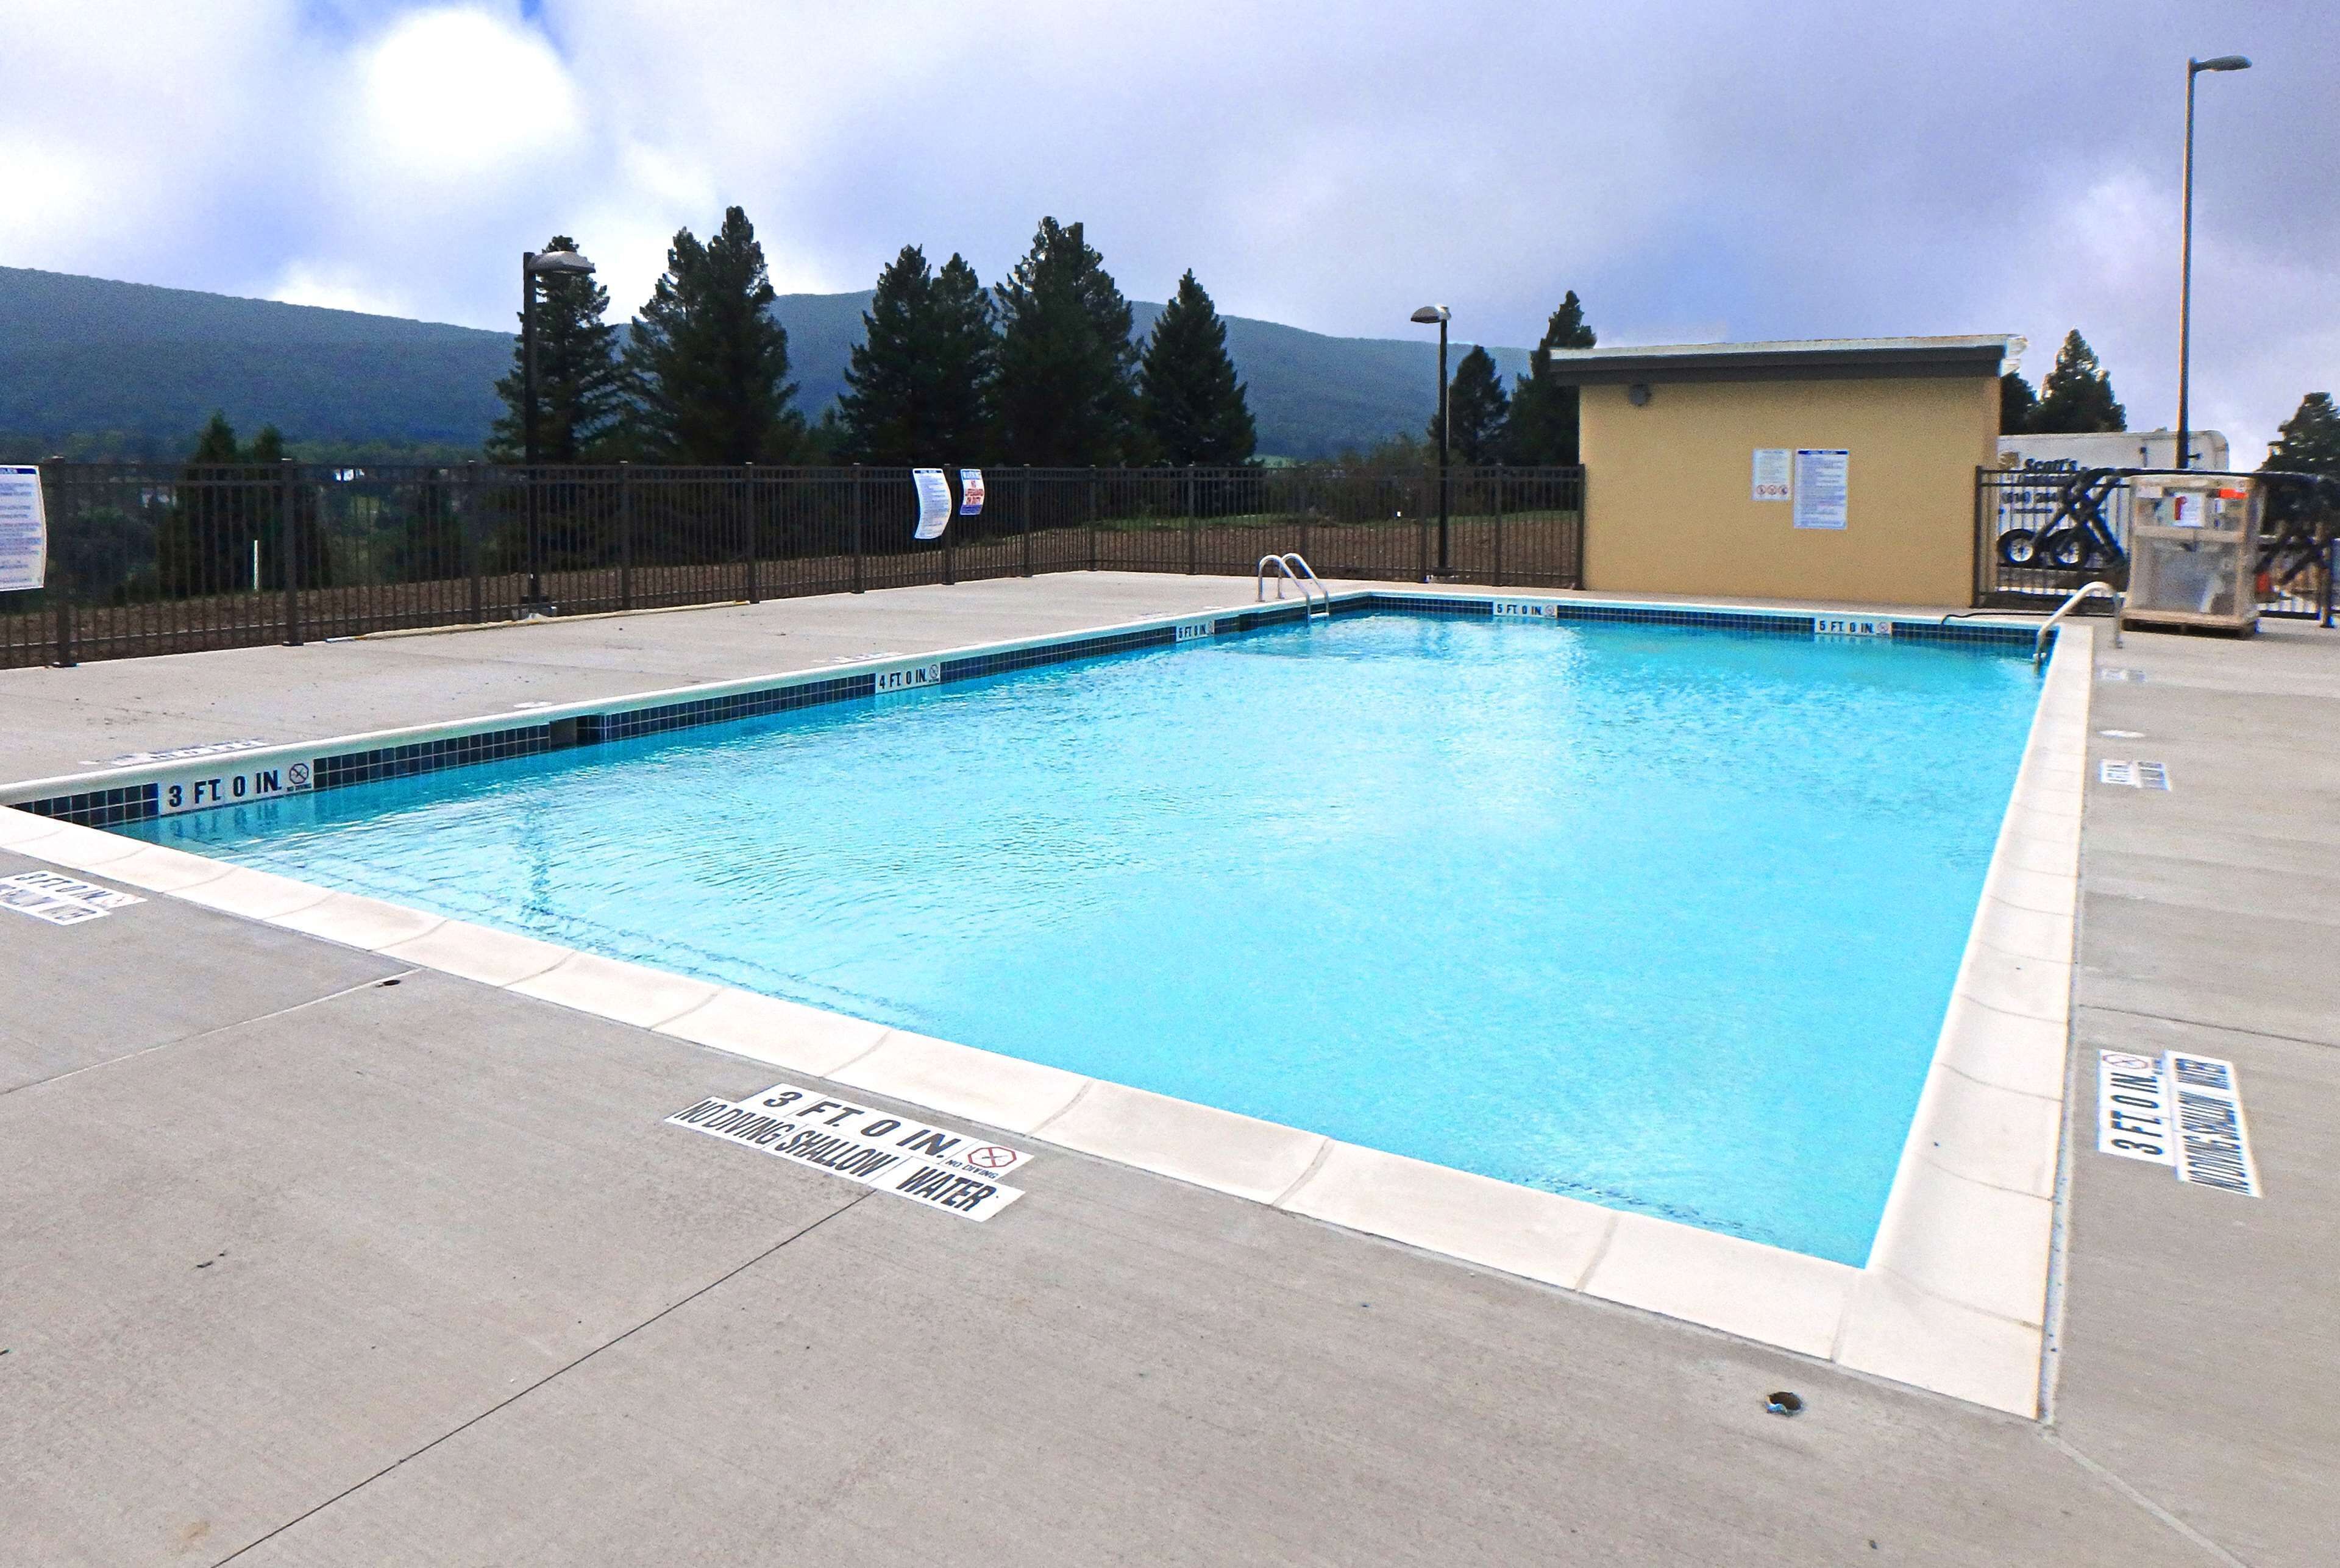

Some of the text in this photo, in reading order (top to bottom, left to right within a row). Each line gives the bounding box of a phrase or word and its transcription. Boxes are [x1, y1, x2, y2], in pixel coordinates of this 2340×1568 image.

[1498, 605, 1502, 613] 5
[880, 675, 885, 689] 4
[169, 785, 182, 807] 3
[194, 779, 221, 804] FT.
[256, 770, 282, 793] IN.
[763, 1092, 803, 1107] 3
[796, 1101, 864, 1127] FT.
[896, 1129, 961, 1158] IN.
[674, 1101, 997, 1211] NO DIVING SHALLOW WATER
[2111, 1138, 2163, 1155] 3
[945, 1160, 998, 1179] NO DIVING
